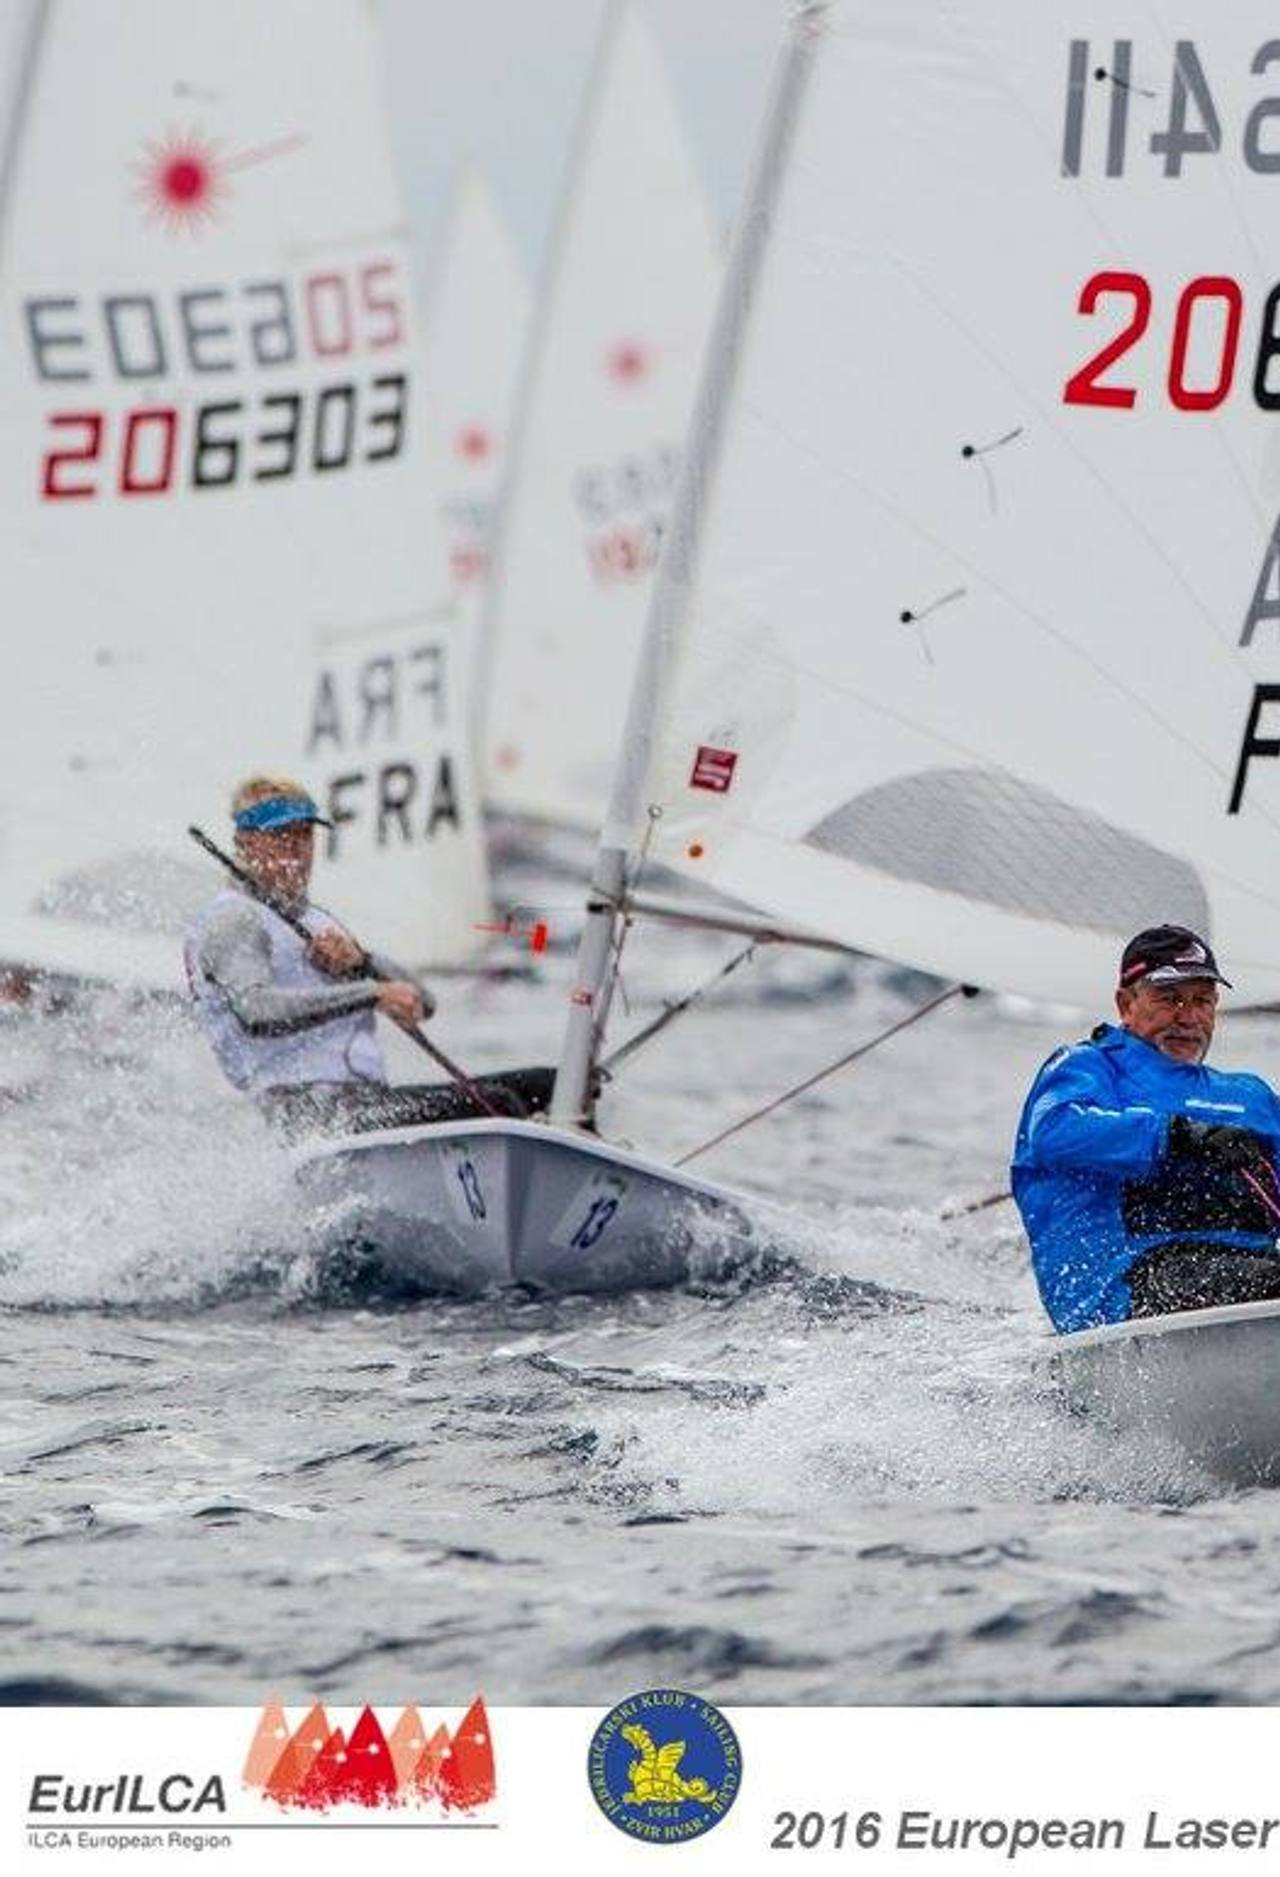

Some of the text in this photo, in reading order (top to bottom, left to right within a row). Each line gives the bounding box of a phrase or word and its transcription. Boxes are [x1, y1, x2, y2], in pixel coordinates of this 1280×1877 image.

[40, 373, 407, 500] 206303
[326, 754, 462, 862] FRA
[570, 1197, 619, 1249] 13
